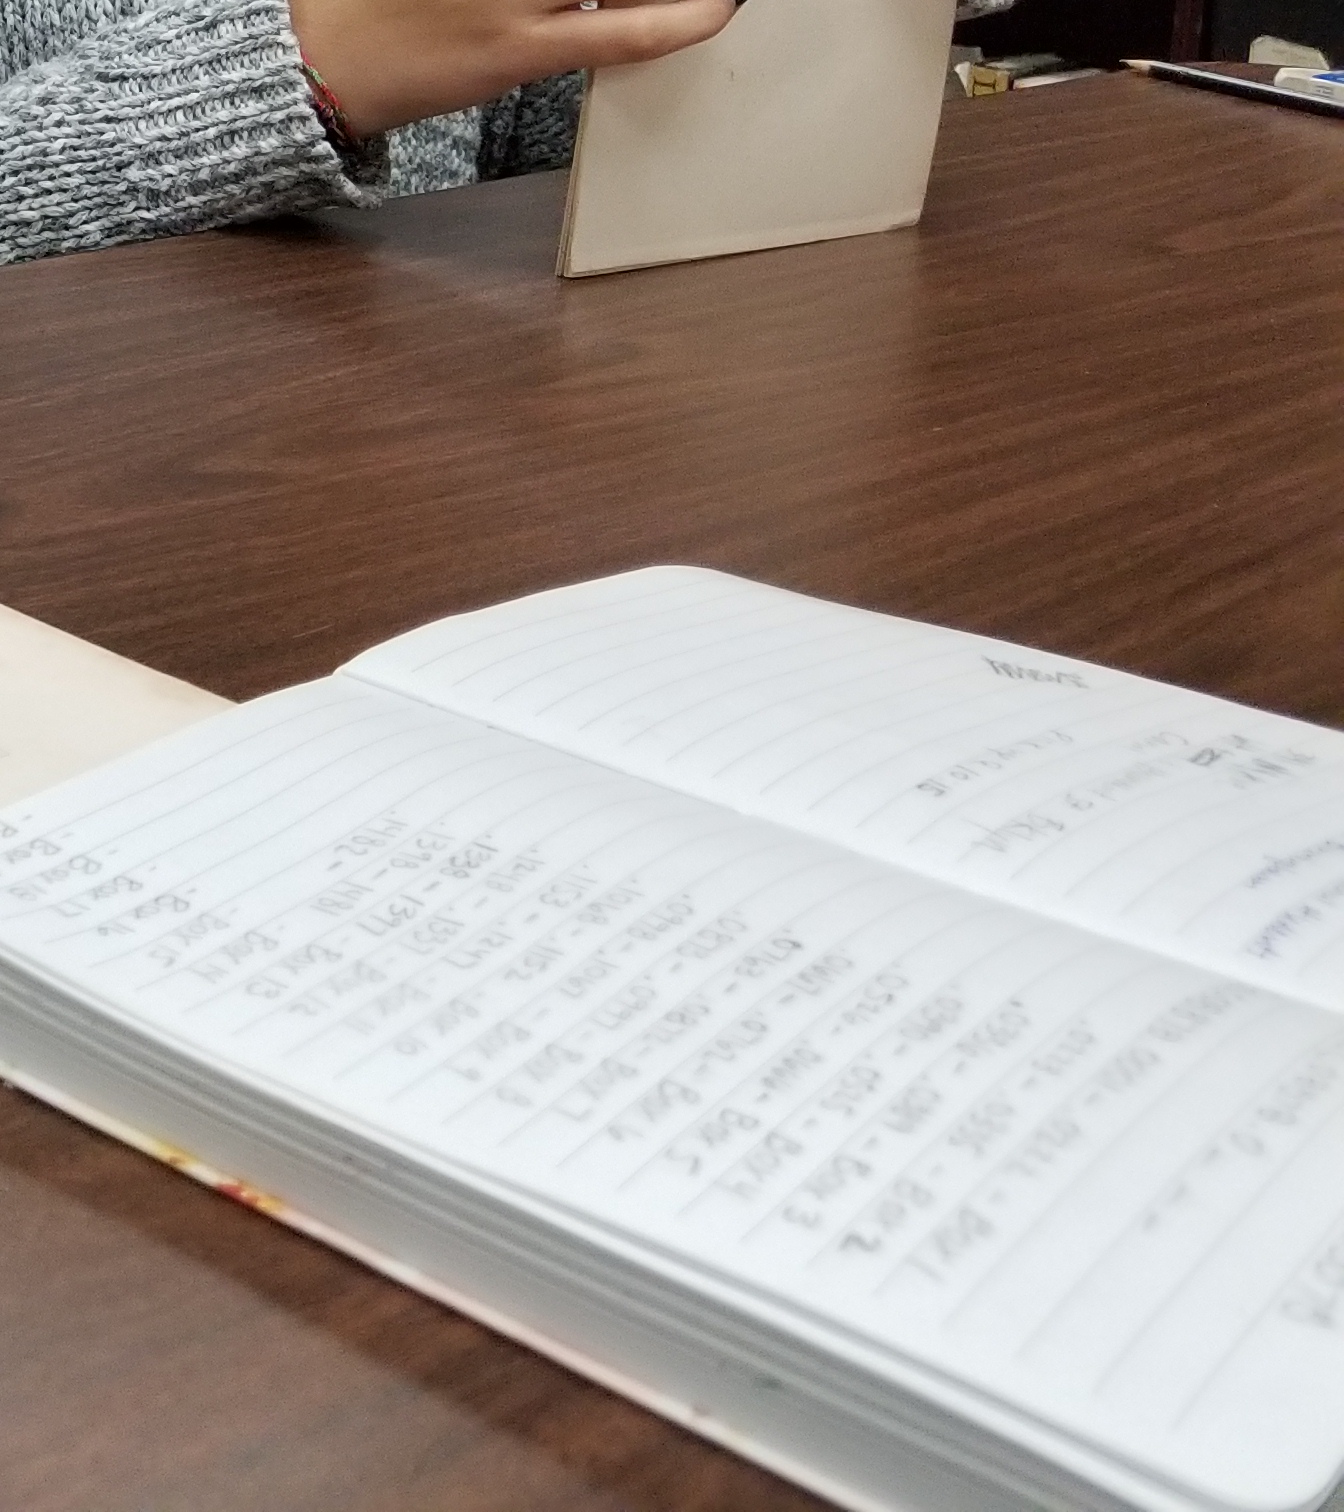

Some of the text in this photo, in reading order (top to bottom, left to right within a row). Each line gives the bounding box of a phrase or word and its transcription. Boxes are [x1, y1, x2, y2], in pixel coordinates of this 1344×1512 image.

[35, 855, 103, 886] Box
[84, 875, 142, 903] Box
[125, 893, 190, 923] Box
